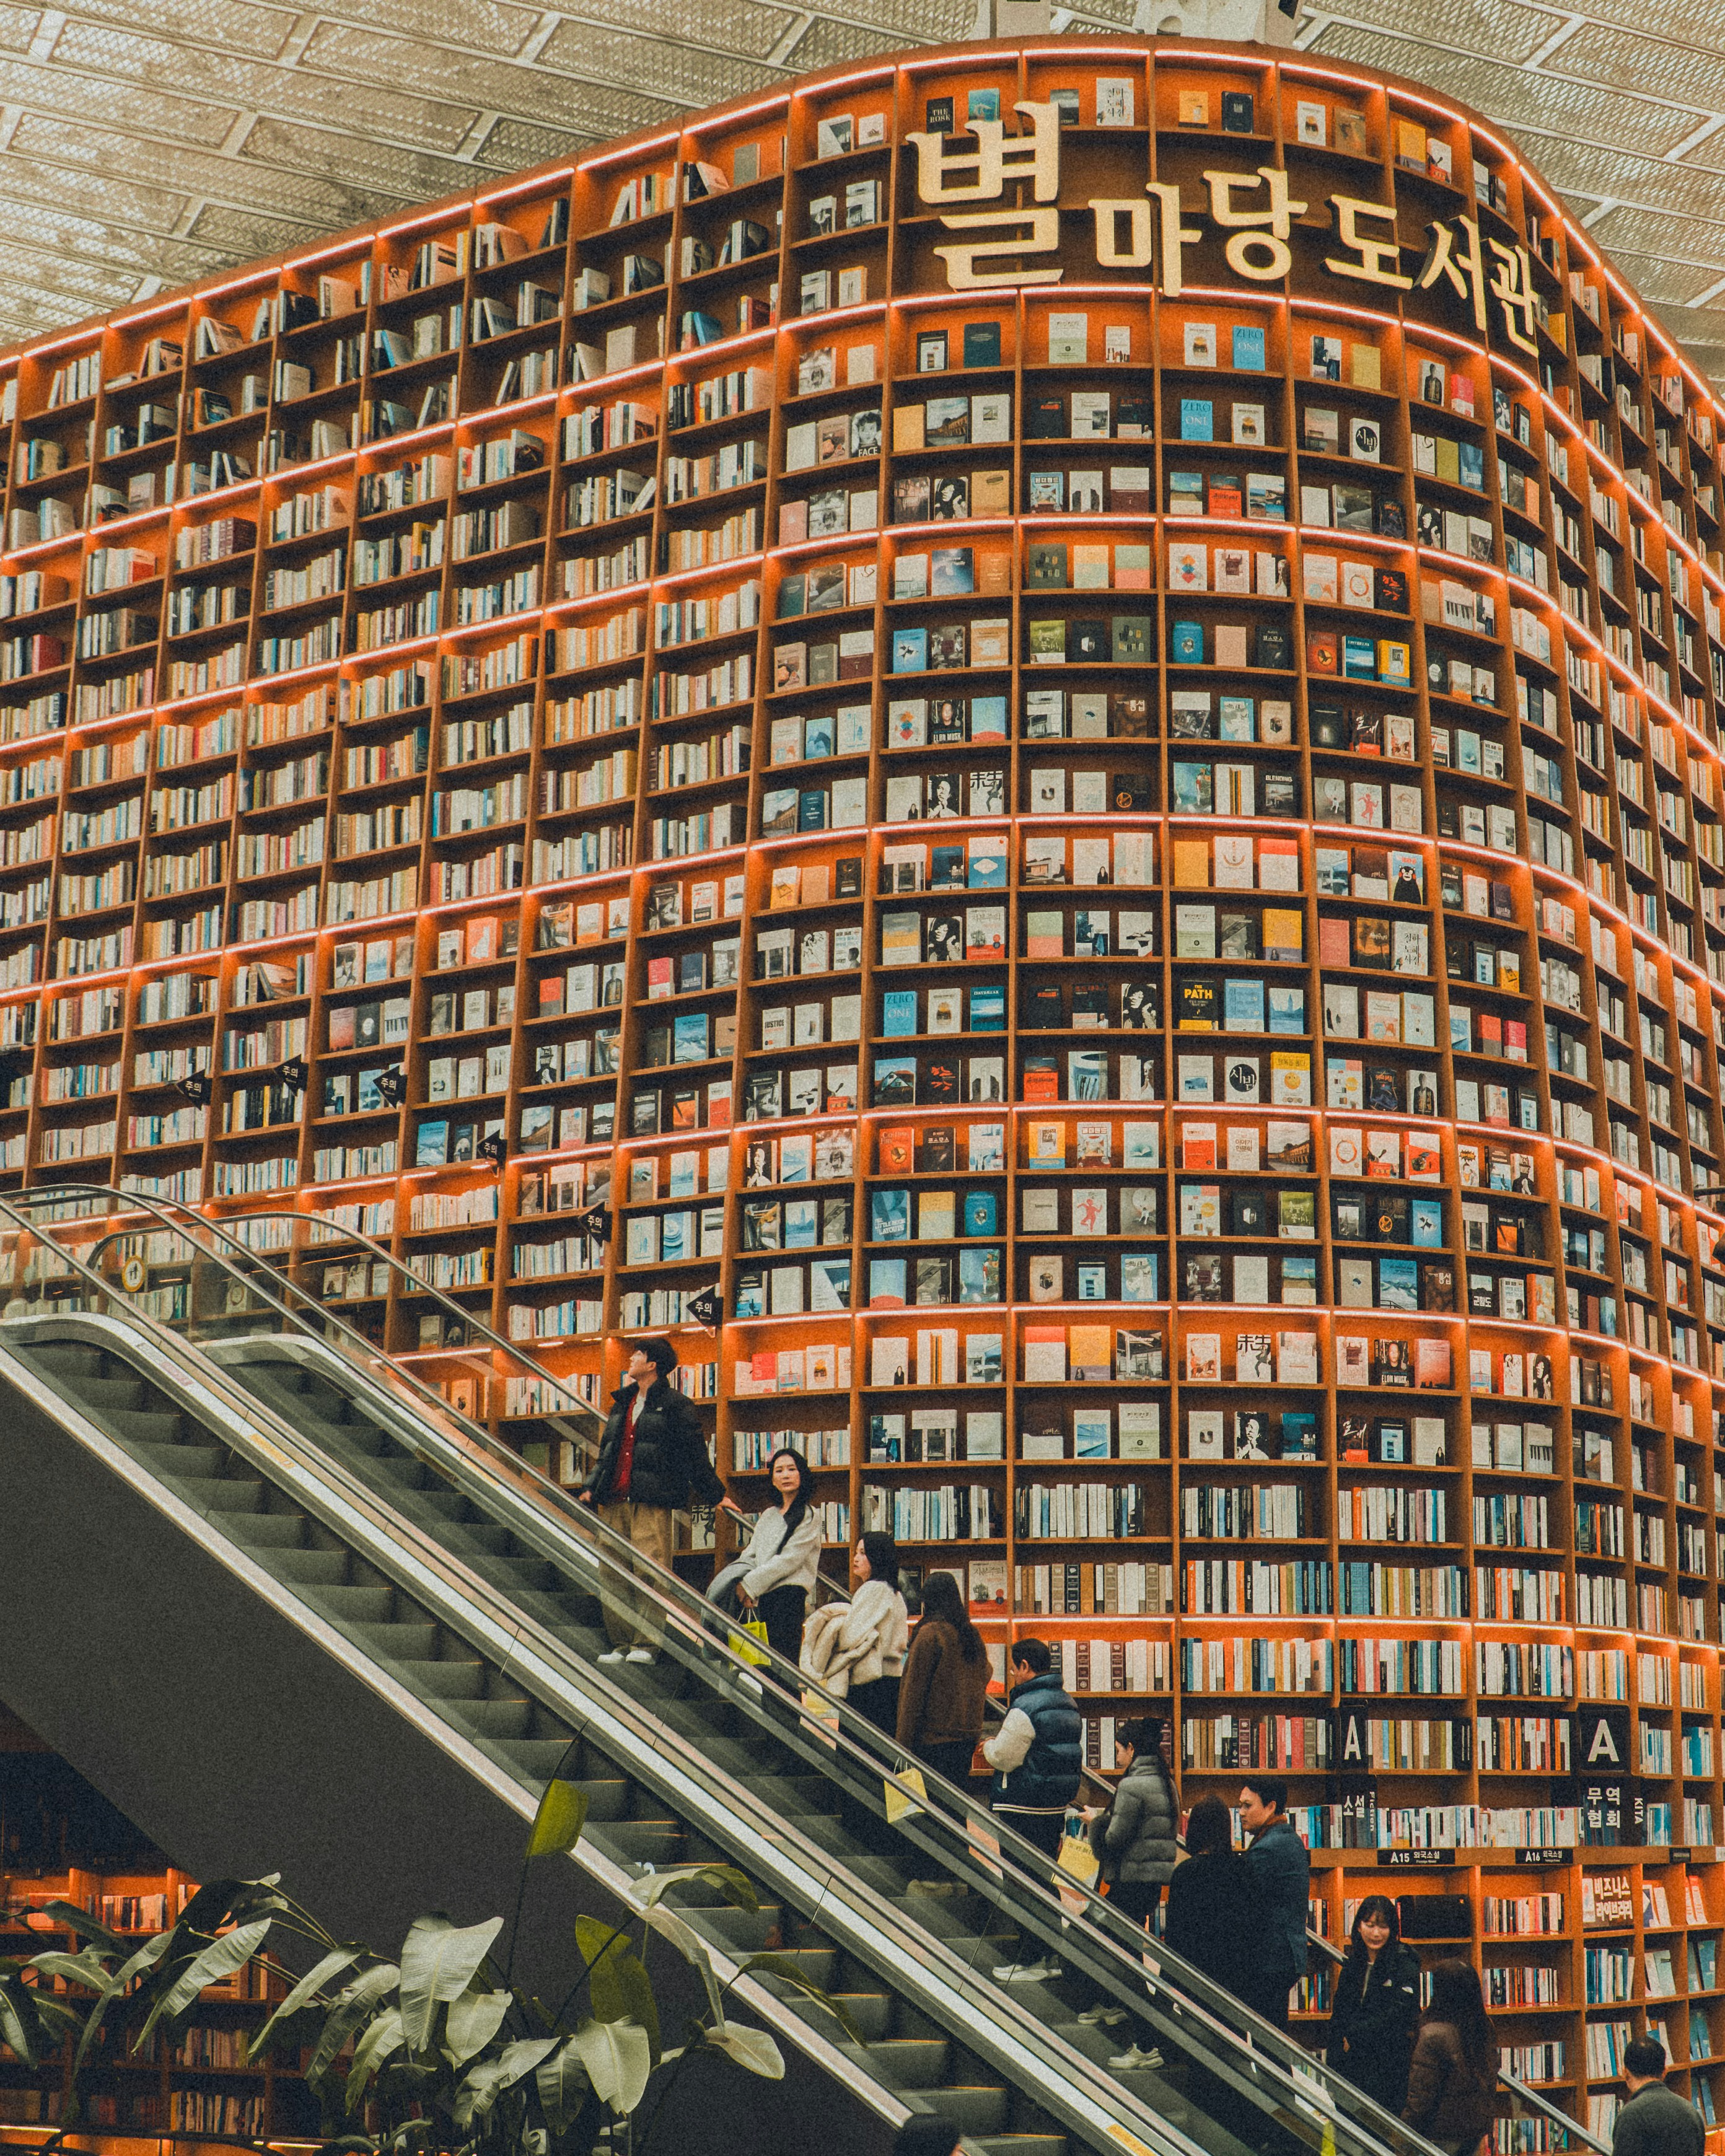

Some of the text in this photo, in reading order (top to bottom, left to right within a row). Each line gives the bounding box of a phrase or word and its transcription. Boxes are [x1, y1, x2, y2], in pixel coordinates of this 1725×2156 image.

[1236, 328, 1263, 339] ZERO
[1183, 401, 1211, 412] ZERO
[858, 446, 879, 457] FACE
[947, 732, 962, 741] MUSK
[1265, 774, 1293, 782] BLENDING
[885, 993, 914, 1004] ZERO
[1184, 989, 1213, 999] PATH
[887, 1007, 911, 1019] ONE
[765, 1019, 784, 1029] JUSTICE
[695, 1301, 713, 1314] 주의
[1381, 1374, 1407, 1383] ELON MUSK
[1343, 1715, 1362, 1761] A
[1587, 1719, 1620, 1763] A
[1587, 1787, 1620, 1806] 무역
[1343, 1795, 1365, 1818] 소설
[1634, 1797, 1644, 1825] KITA
[1587, 1809, 1620, 1828] 협회
[1390, 1851, 1440, 1864] A15 외국소설
[1525, 1849, 1563, 1862] A16 외국소설
[1594, 1875, 1631, 1900] 비즈니스
[1595, 1900, 1633, 1921] 라이브러리
